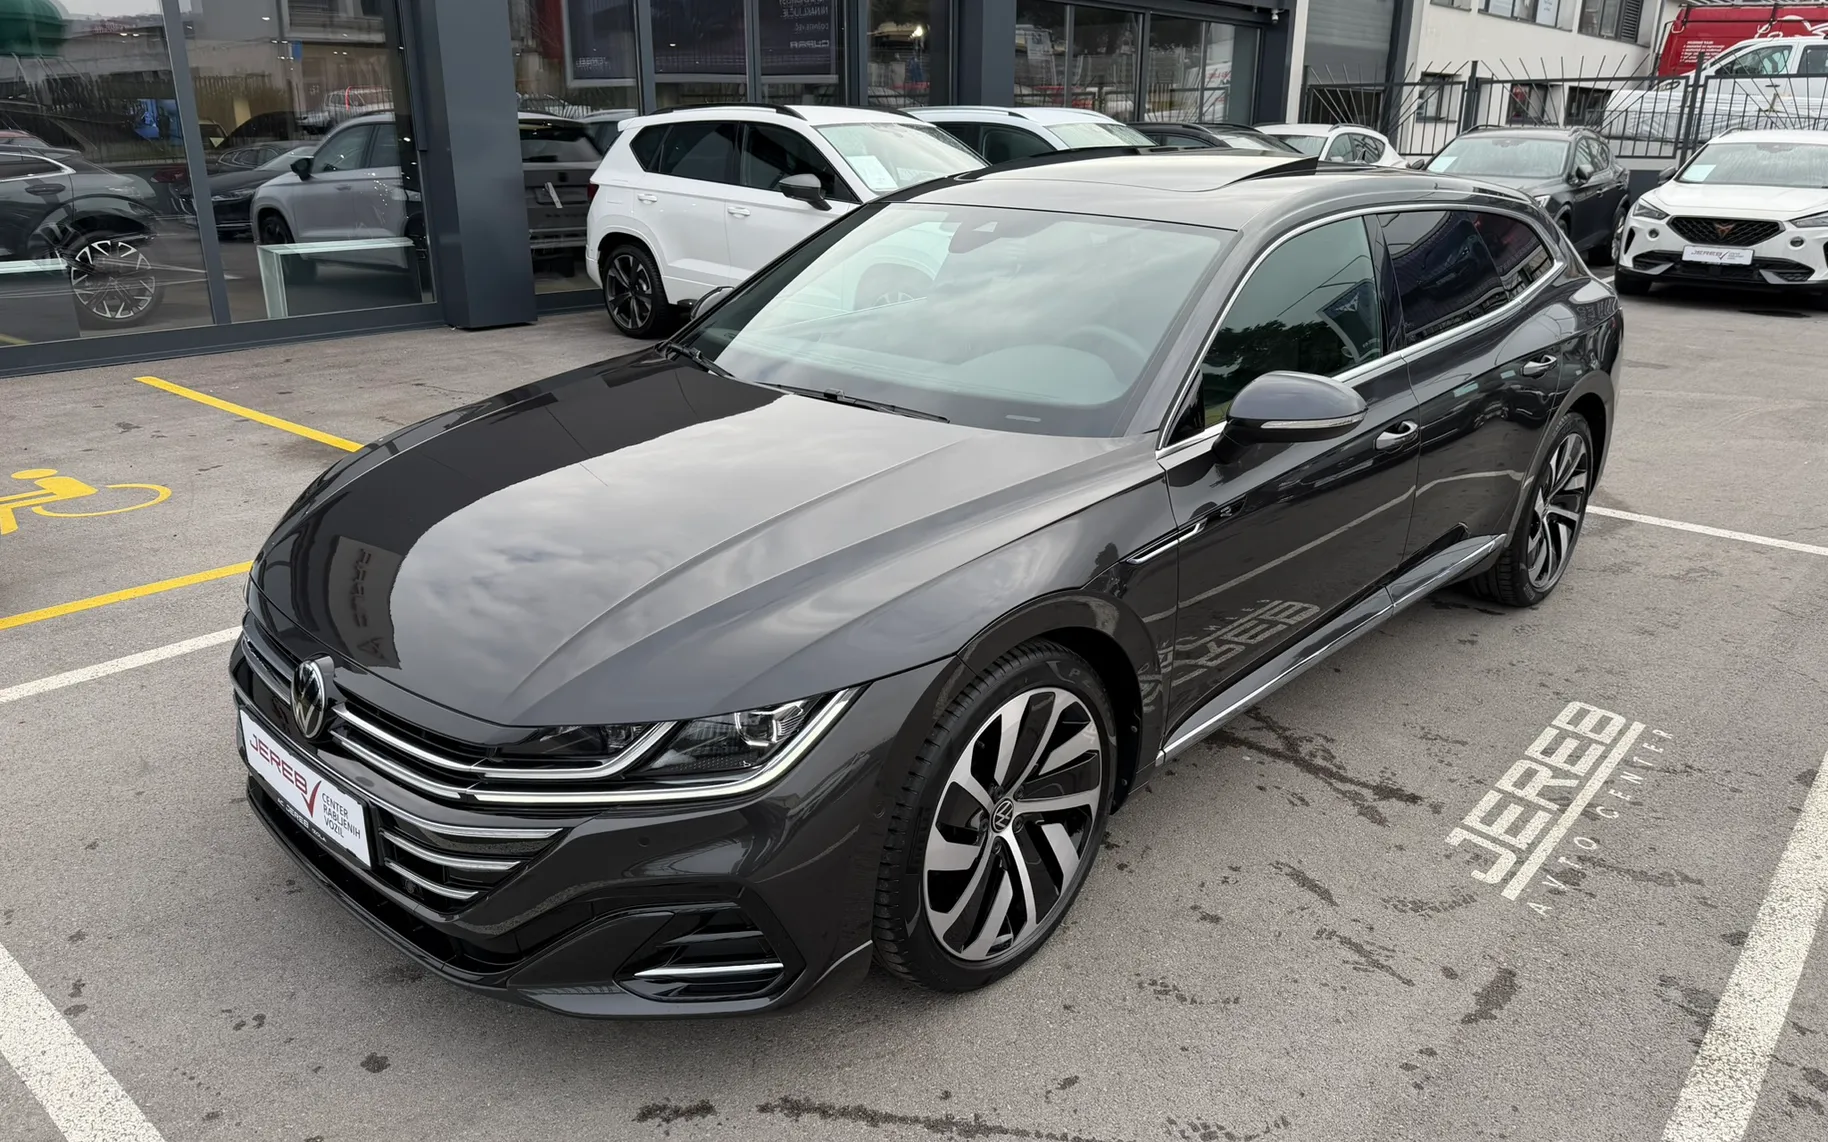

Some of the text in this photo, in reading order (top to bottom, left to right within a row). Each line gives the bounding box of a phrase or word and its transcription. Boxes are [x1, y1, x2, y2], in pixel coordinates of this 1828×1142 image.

[249, 733, 308, 796] JEREB
[321, 792, 349, 820] CENTER
[1444, 701, 1627, 884] JEREB
[322, 803, 361, 840] RABLJENIH
[323, 814, 345, 839] VOZIL
[1526, 728, 1675, 917] AVTO CENTER
